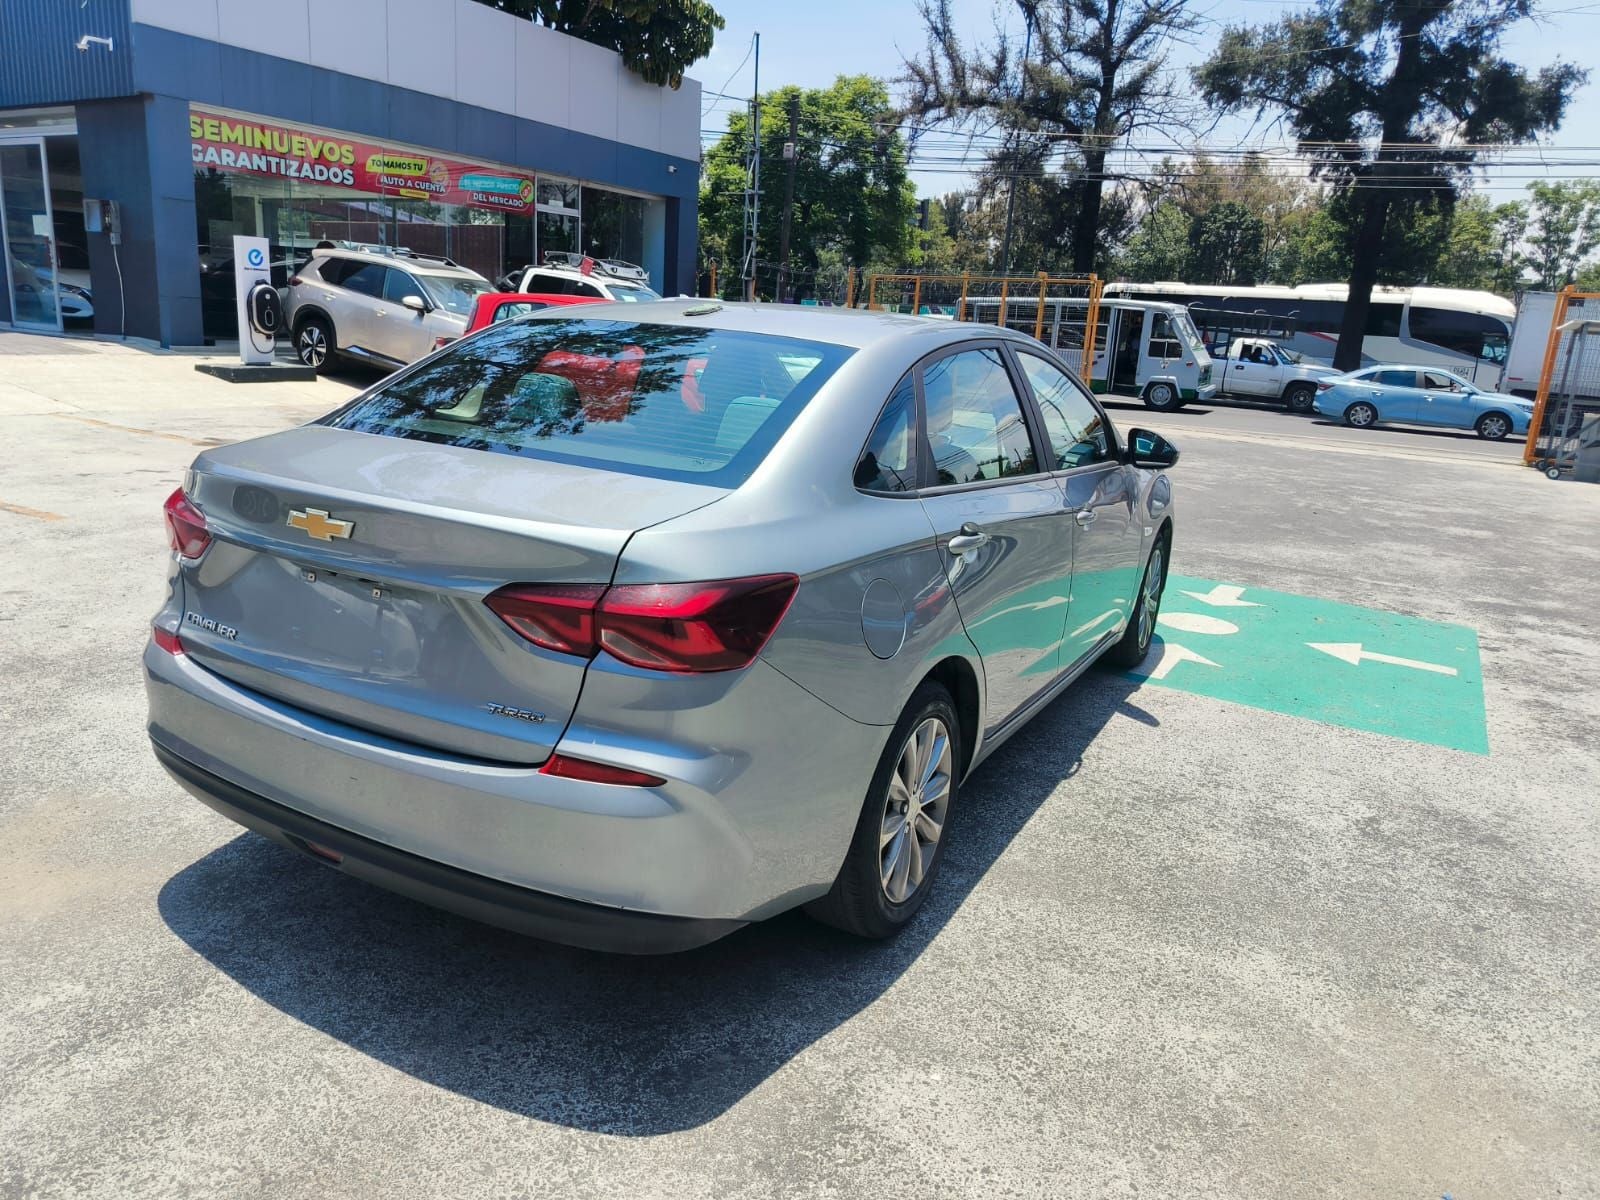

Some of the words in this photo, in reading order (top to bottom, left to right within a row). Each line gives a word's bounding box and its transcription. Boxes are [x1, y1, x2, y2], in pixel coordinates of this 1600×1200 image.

[189, 115, 355, 165] SEMINUEVOS
[191, 143, 355, 186] GARANTIZADOS
[371, 159, 411, 170] TOMAMOS
[414, 163, 423, 171] TU
[381, 175, 405, 186] AUTO
[407, 179, 414, 187] A
[415, 181, 446, 193] CUENTA
[473, 192, 487, 201] DEL
[488, 194, 524, 207] MERCADO
[187, 611, 238, 641] CAVALIER
